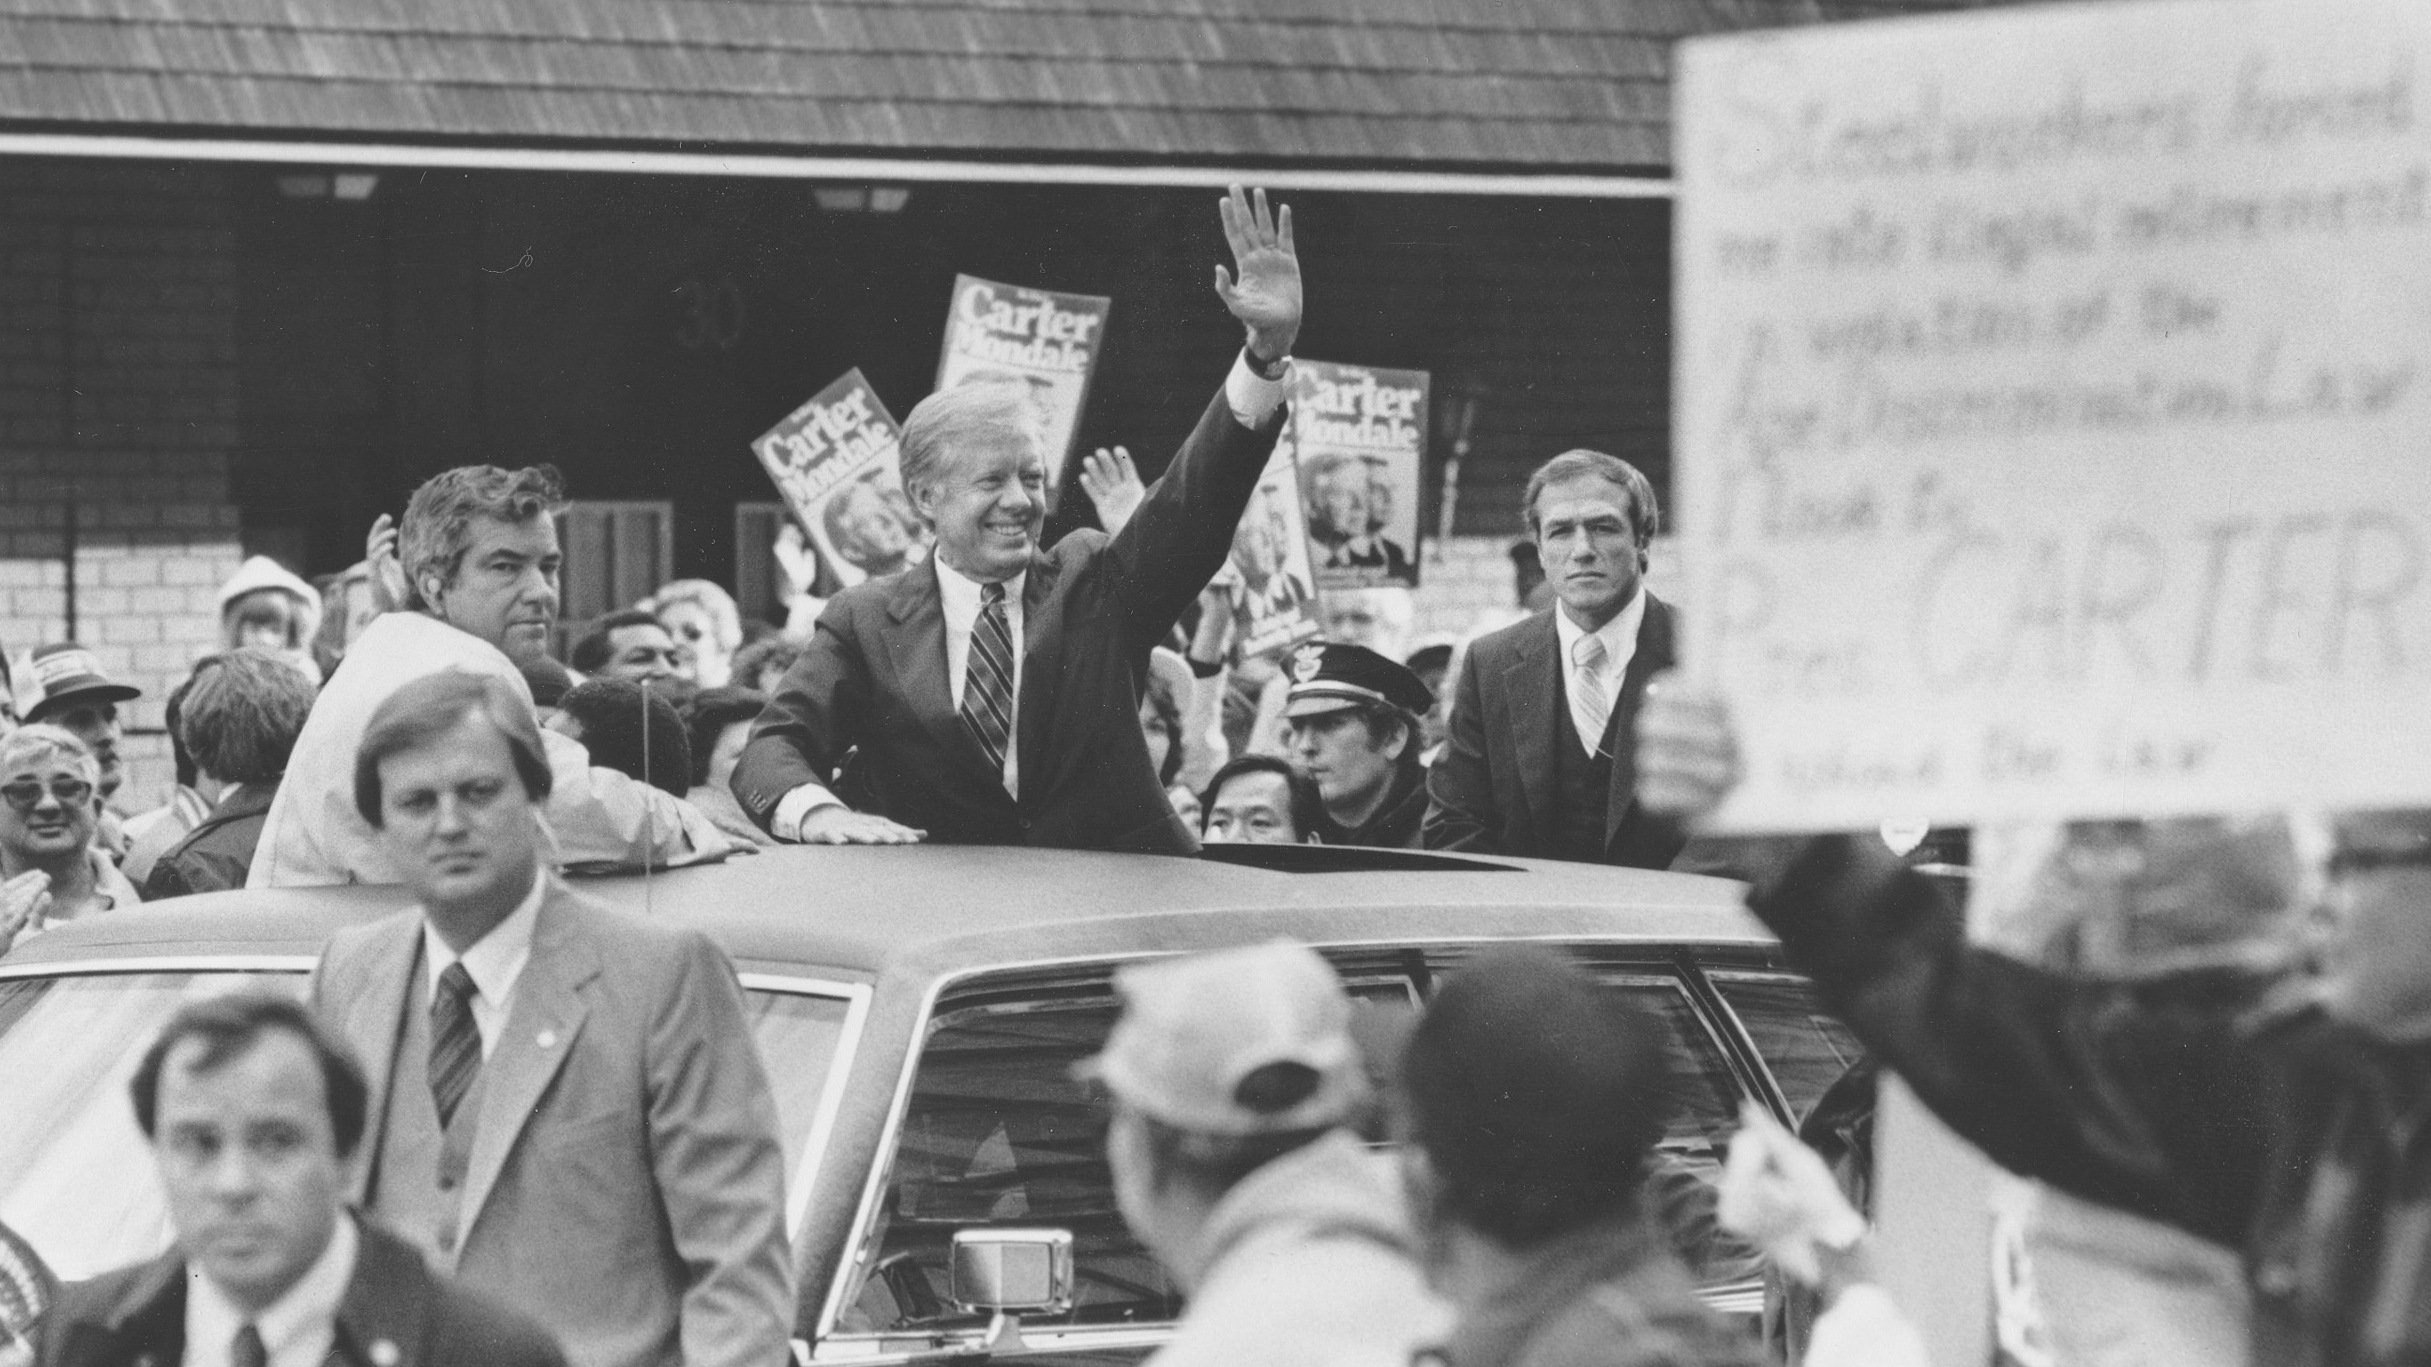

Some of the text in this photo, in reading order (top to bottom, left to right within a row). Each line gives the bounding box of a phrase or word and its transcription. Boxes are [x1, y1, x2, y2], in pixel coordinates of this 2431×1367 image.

[950, 321, 1089, 372] Mondale
[960, 283, 1100, 343] Carter
[763, 386, 873, 477] Carter
[781, 422, 894, 506] Mondale
[1906, 506, 2424, 695] CARTER
